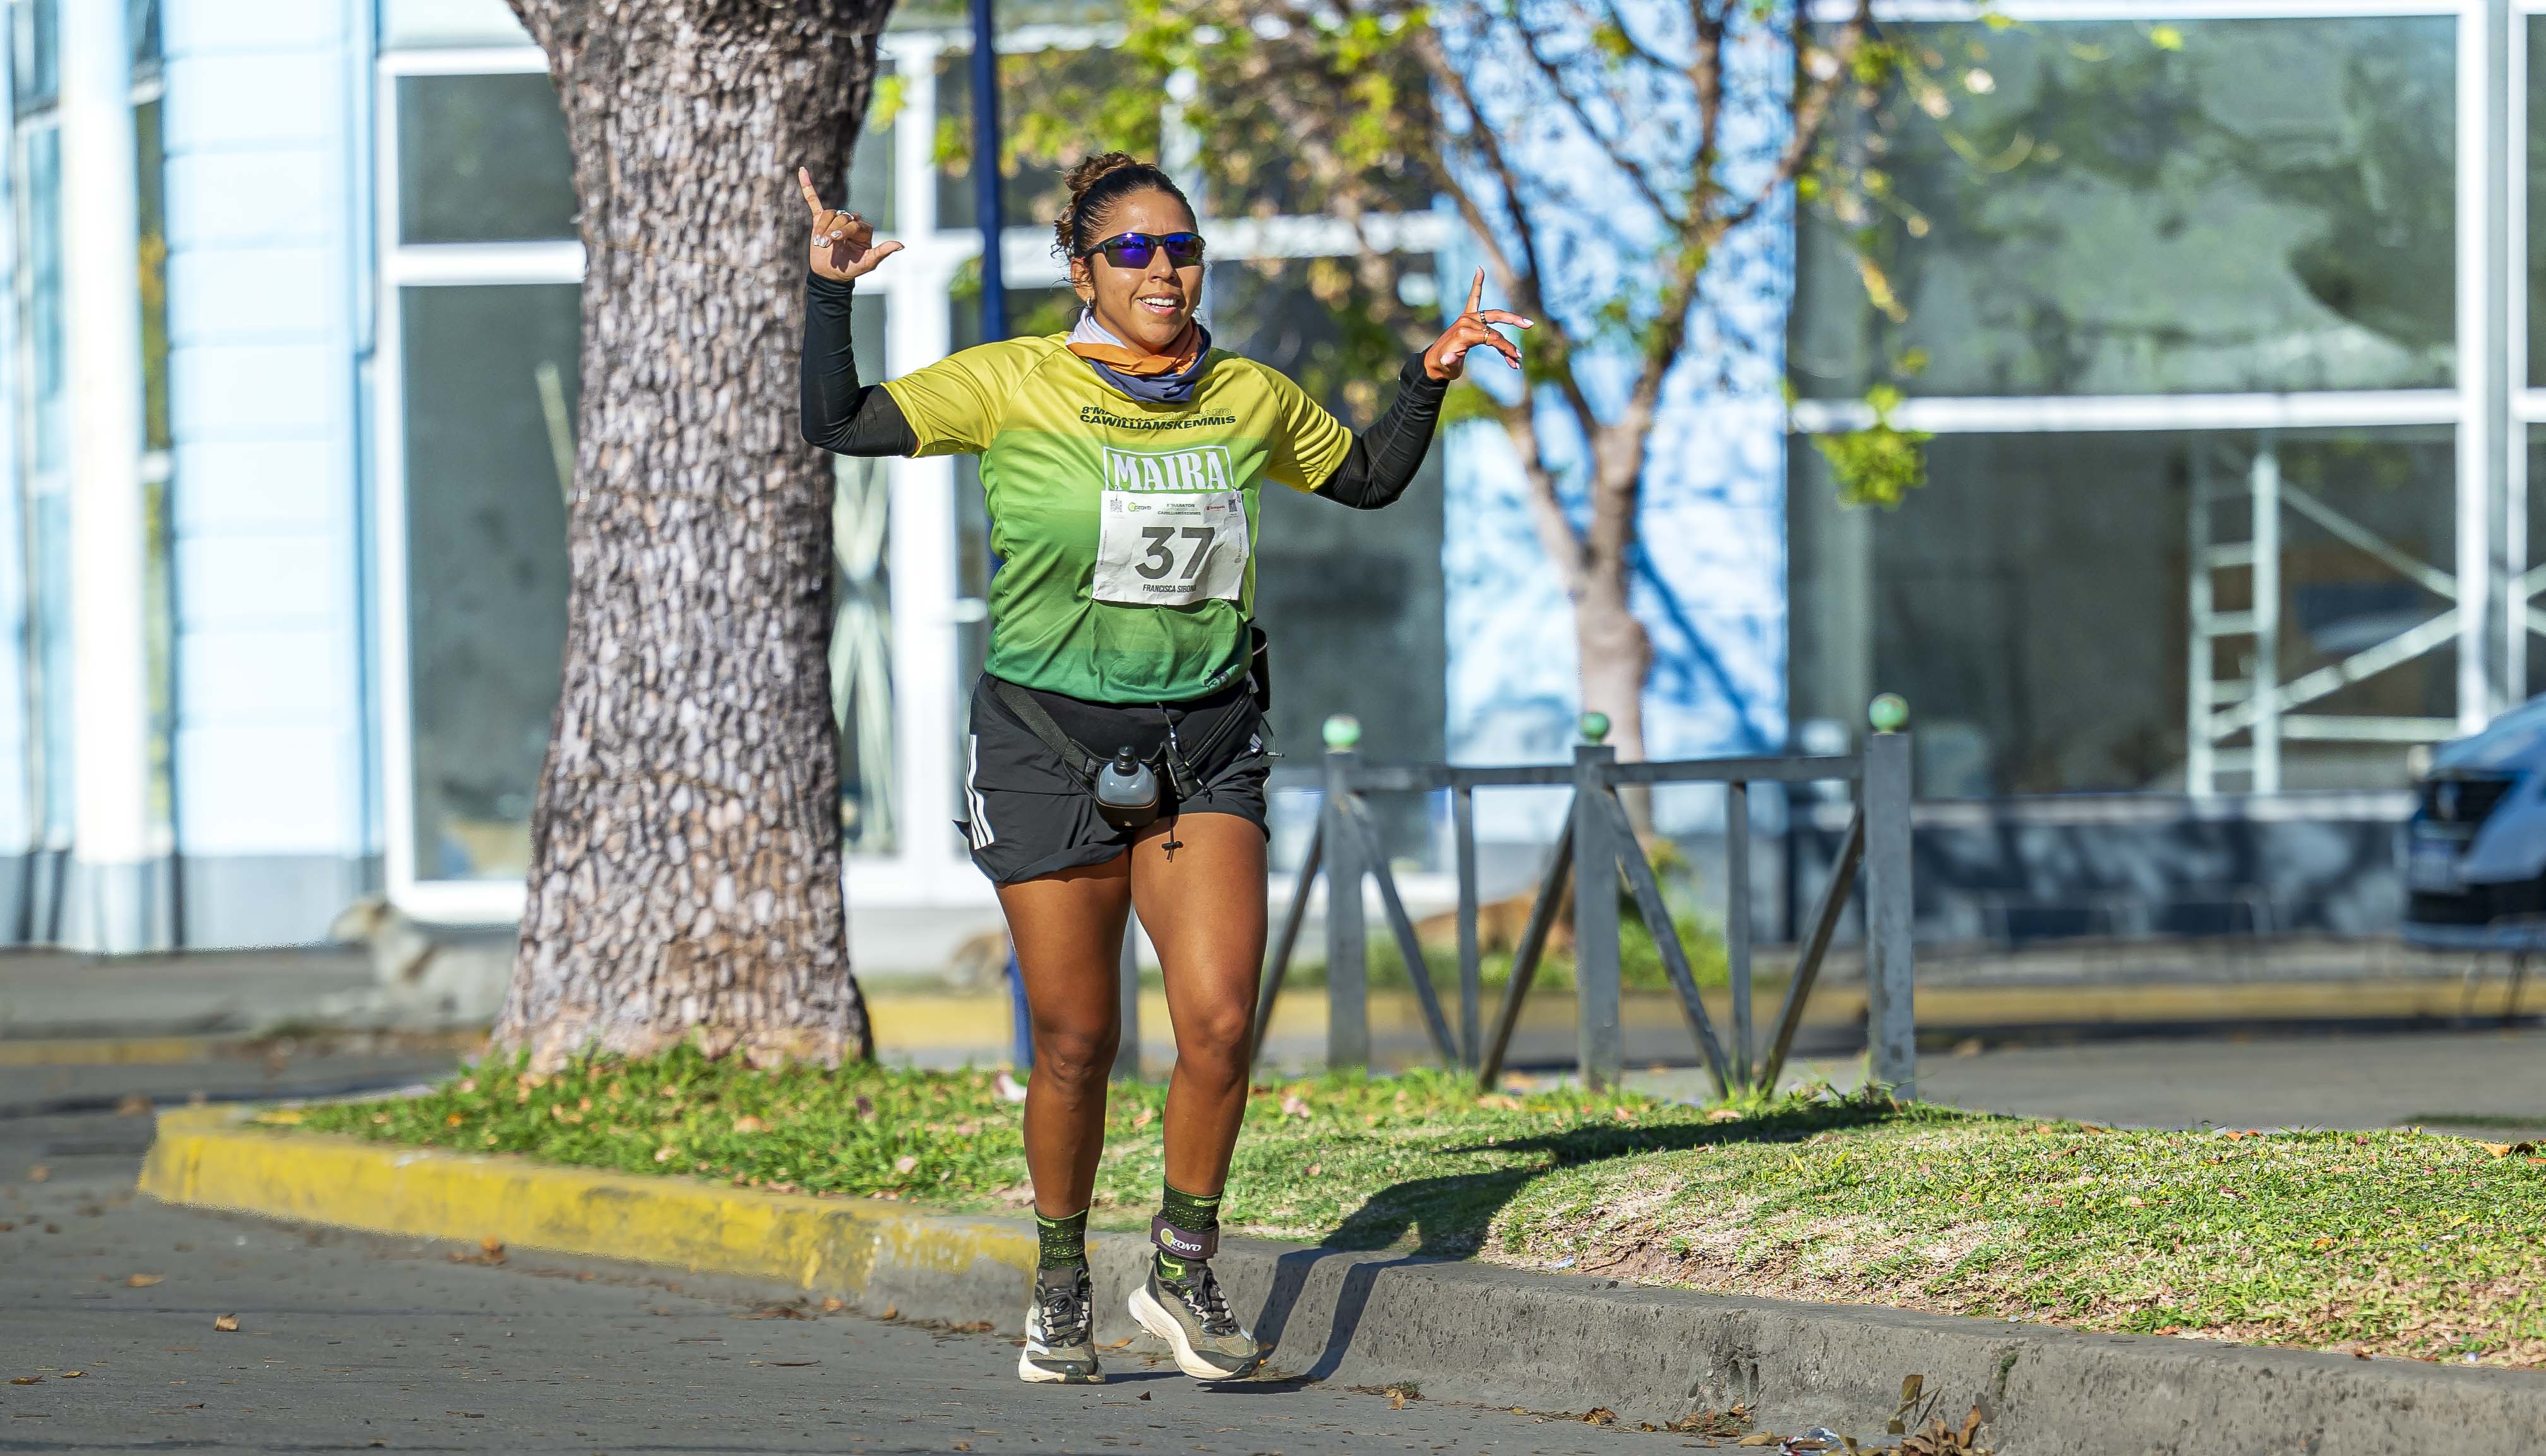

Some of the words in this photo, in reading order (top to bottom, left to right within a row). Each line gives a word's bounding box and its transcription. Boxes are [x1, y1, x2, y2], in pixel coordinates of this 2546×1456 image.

[1080, 414, 1236, 430] CAWILLIAMSKEMMIS
[1111, 451, 1228, 491] MAIRA
[1134, 527, 1216, 580] 37
[1143, 584, 1176, 593] FRANCISCA
